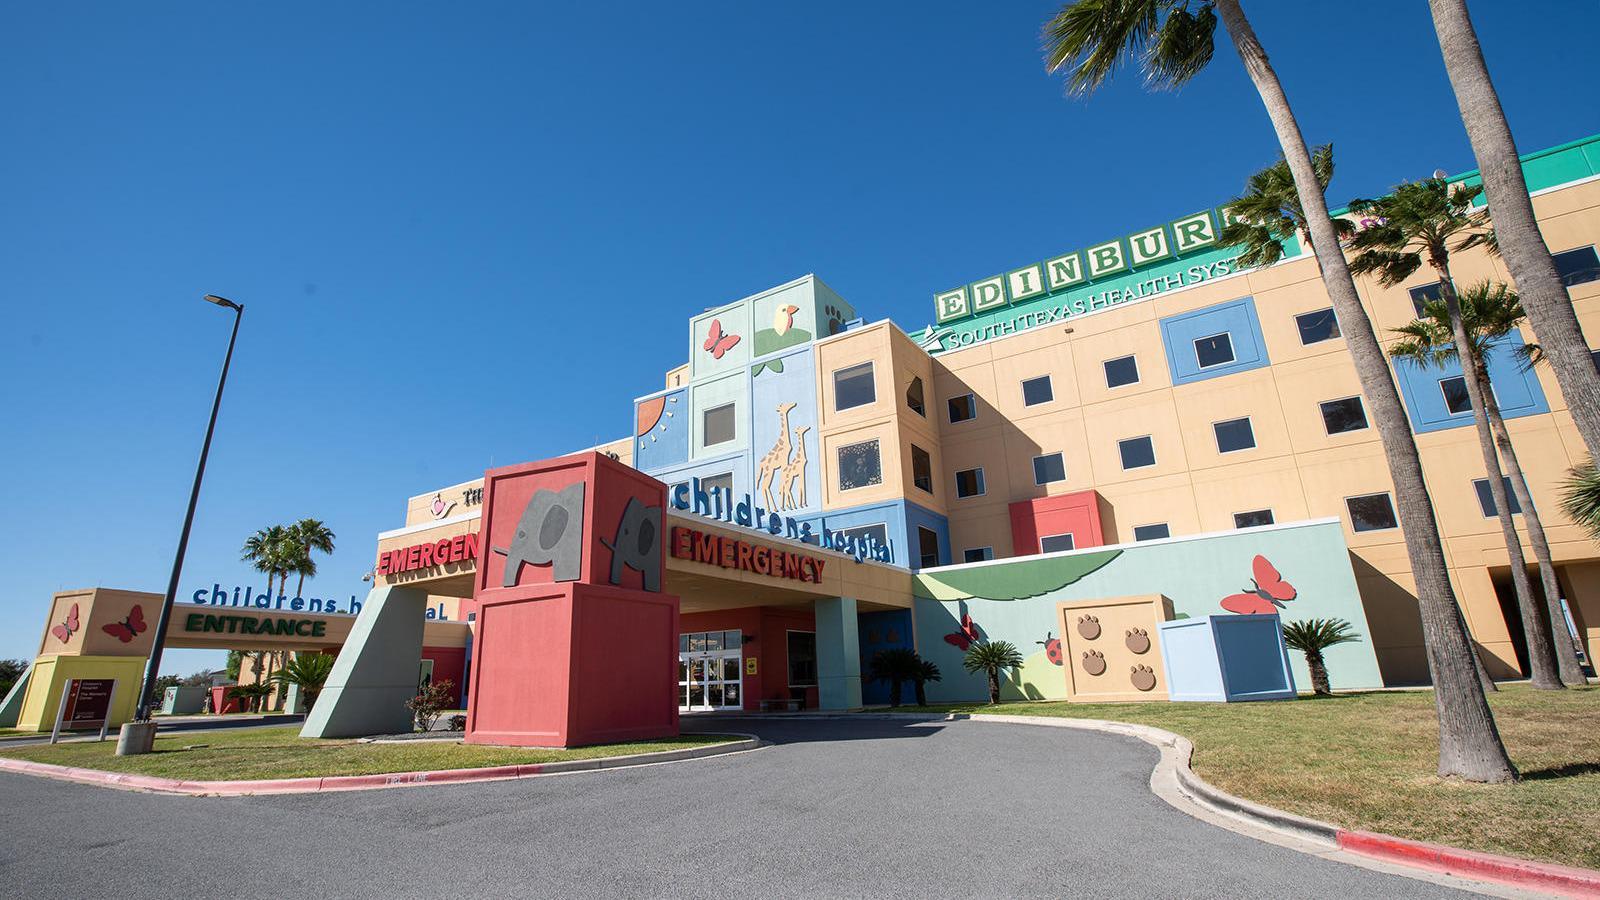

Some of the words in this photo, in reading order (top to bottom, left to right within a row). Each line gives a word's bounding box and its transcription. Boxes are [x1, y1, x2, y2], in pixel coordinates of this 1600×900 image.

[941, 208, 1250, 318] EDINBUR
[948, 320, 1017, 350] SOUTH
[1018, 300, 1087, 328] TEXAS
[1088, 271, 1185, 312] HEALTH
[462, 487, 484, 507] TH
[671, 476, 811, 543] childrens
[822, 517, 895, 563] hospital
[377, 531, 480, 576] EMERGEN
[671, 525, 826, 584] EMERGENCY
[192, 583, 337, 613] childrens
[185, 613, 327, 637] ENTRANCE
